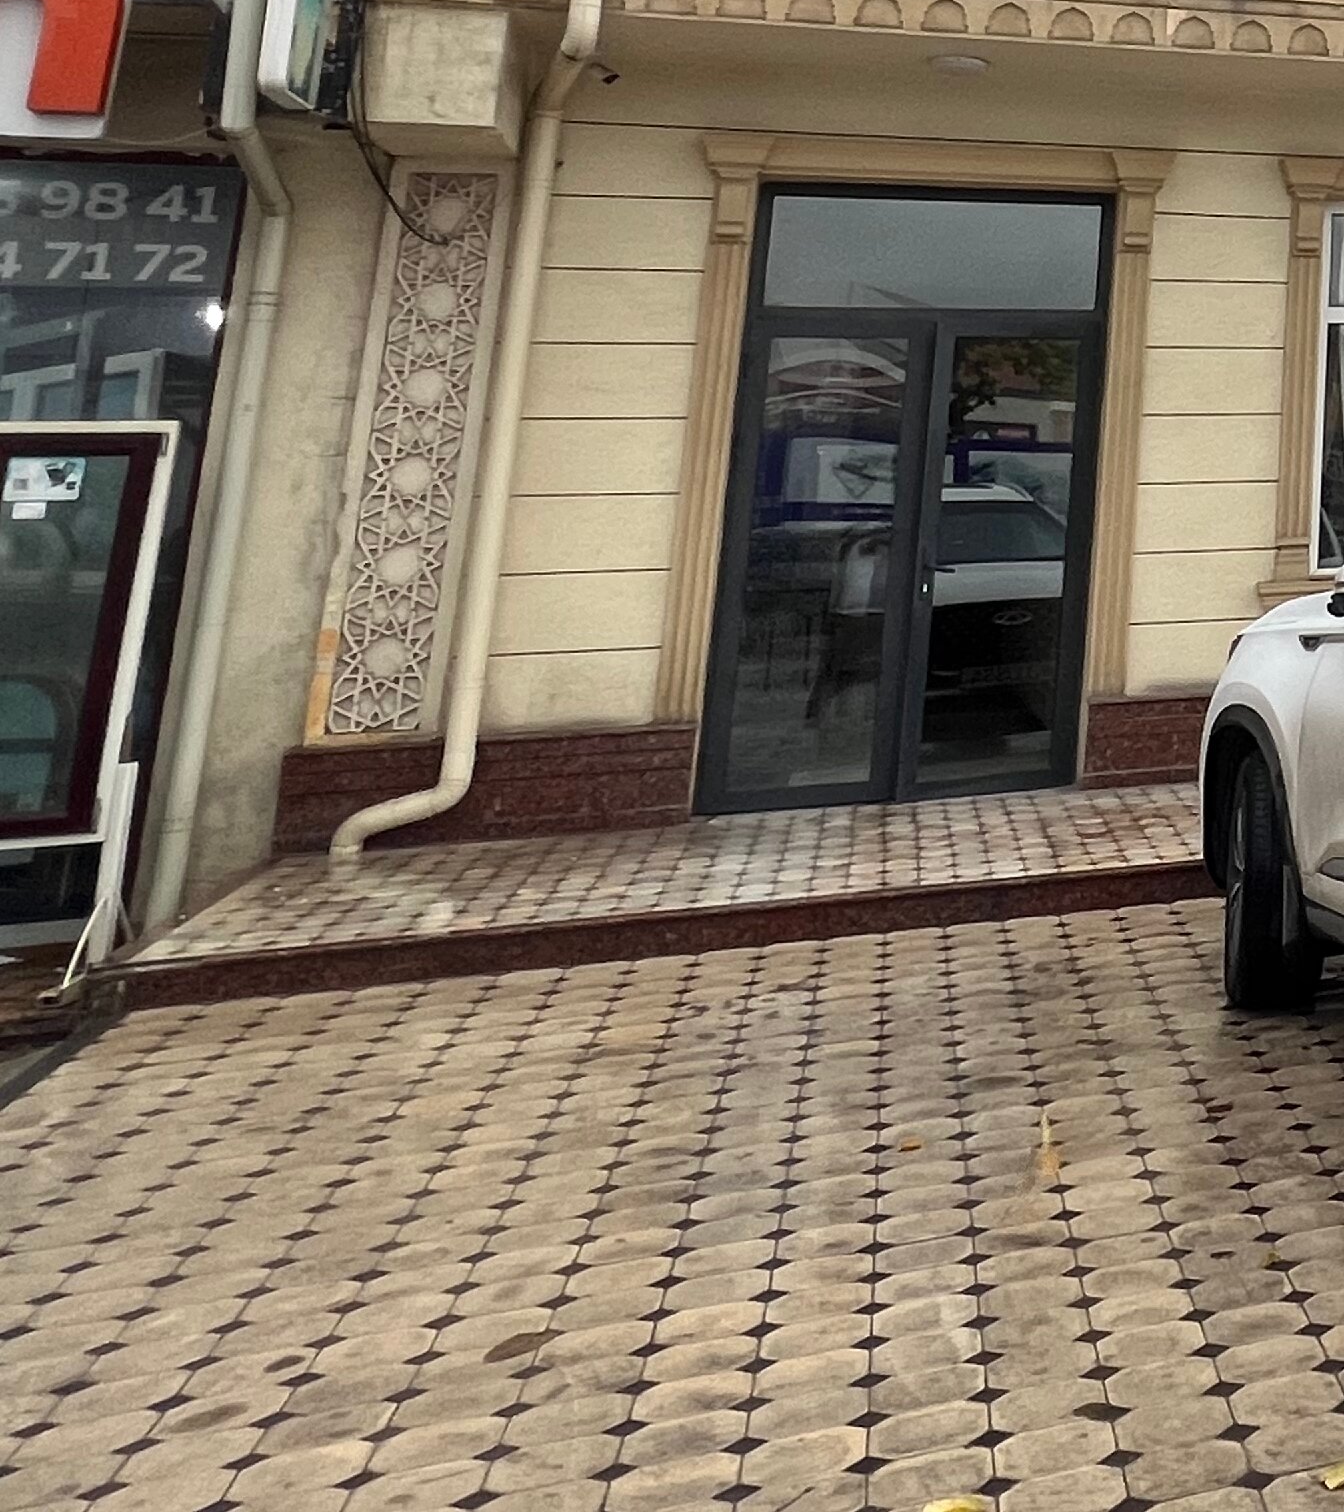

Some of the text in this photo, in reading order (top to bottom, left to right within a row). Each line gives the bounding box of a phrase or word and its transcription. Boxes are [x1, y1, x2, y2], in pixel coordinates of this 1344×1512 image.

[40, 180, 130, 221] 98
[145, 184, 219, 224] 41
[44, 240, 112, 280] 71
[133, 244, 208, 282] 72
